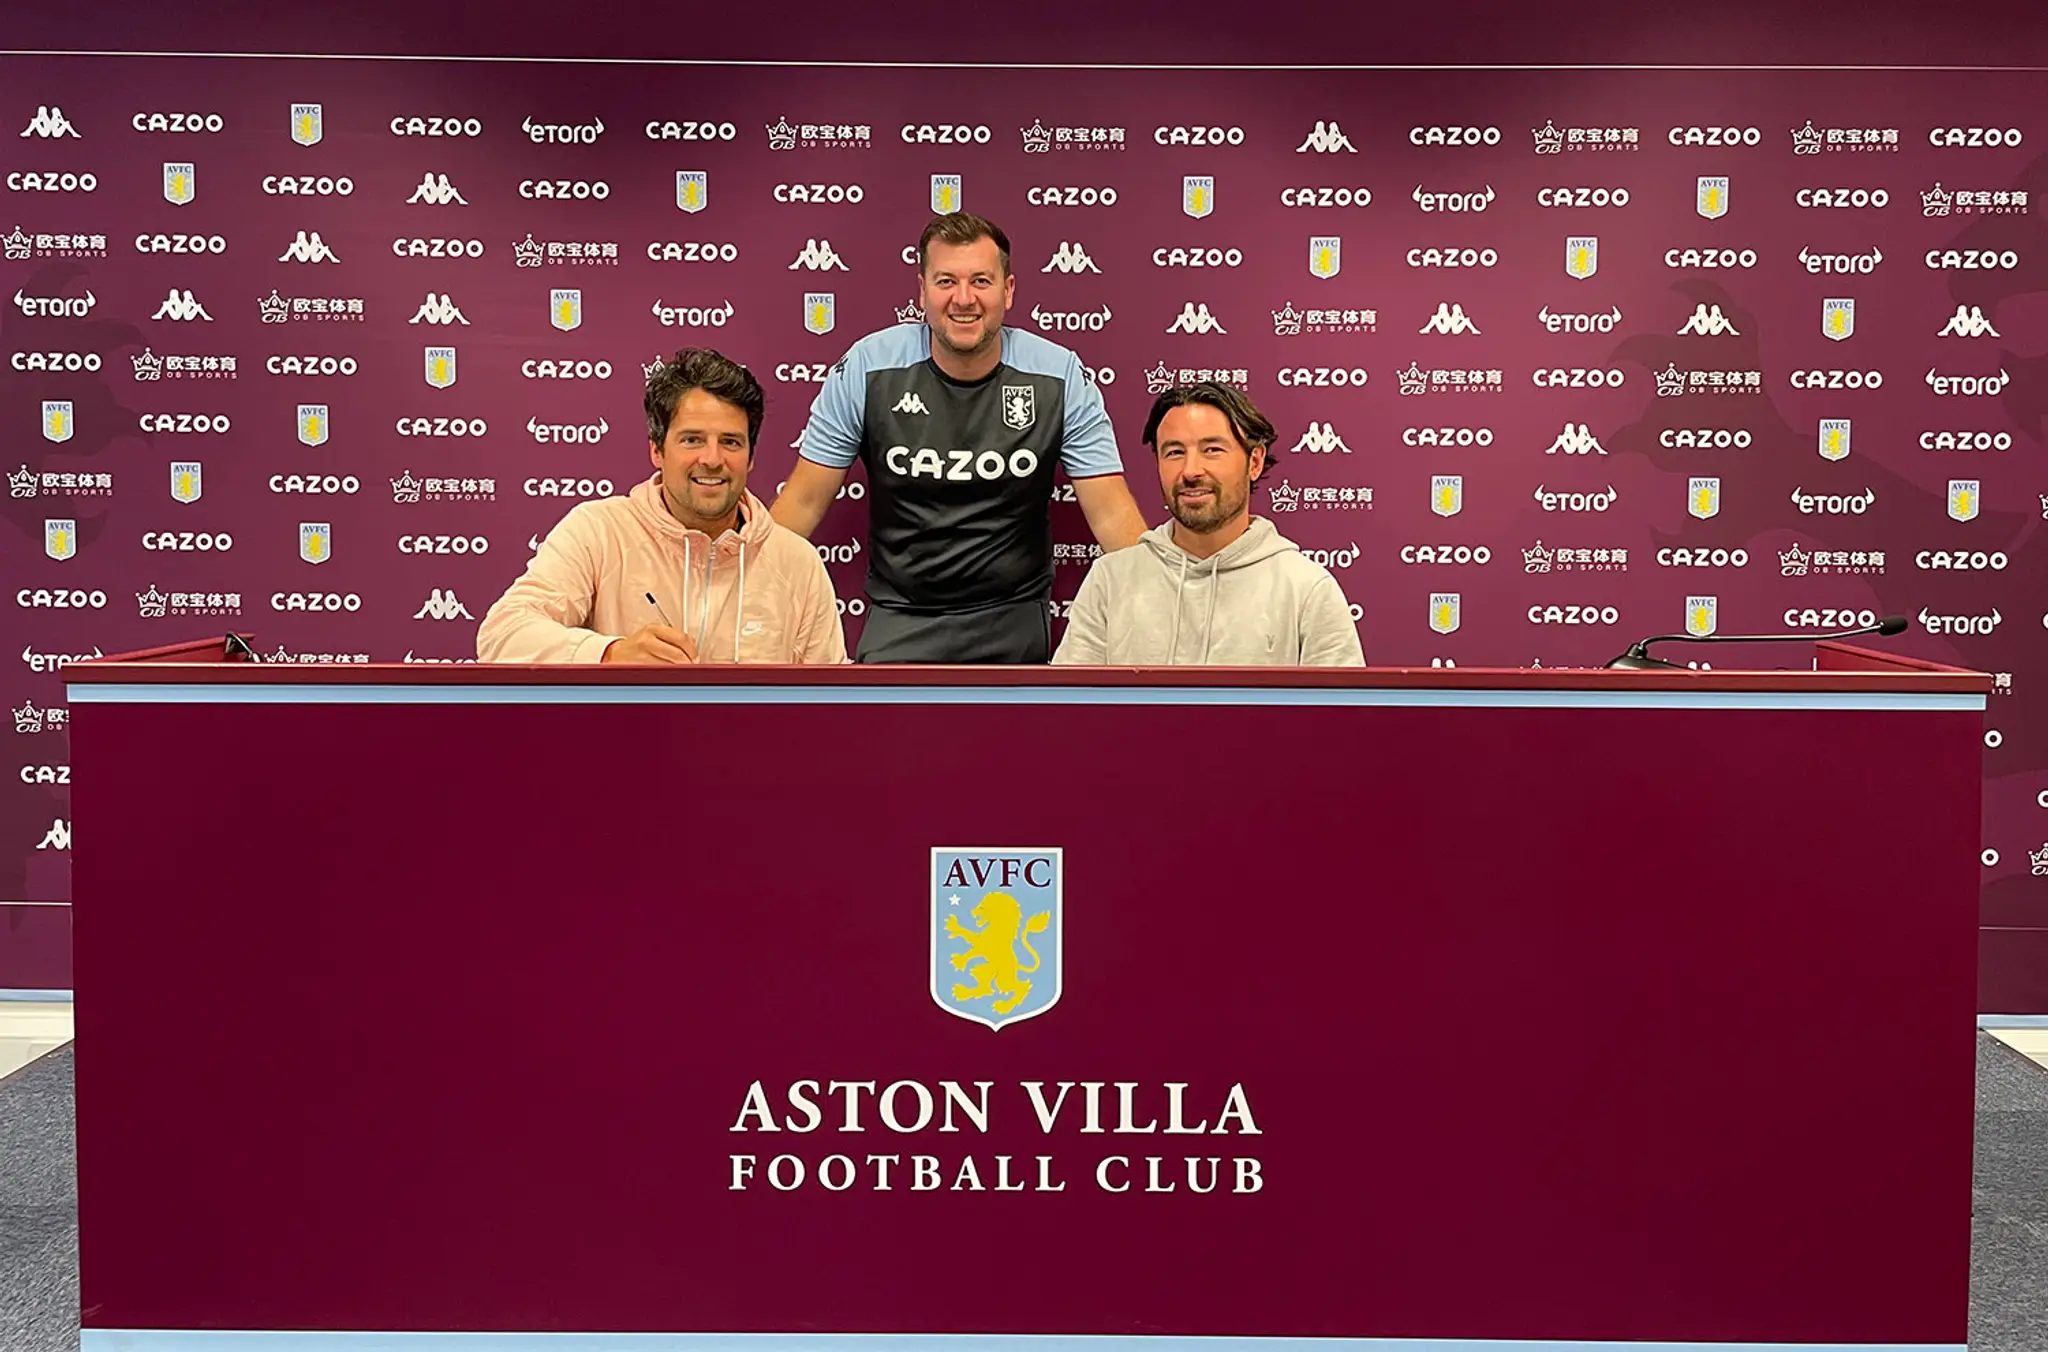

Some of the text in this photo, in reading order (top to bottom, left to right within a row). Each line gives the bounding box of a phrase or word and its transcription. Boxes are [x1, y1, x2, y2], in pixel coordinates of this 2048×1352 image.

[294, 106, 319, 115] AVFC
[132, 112, 224, 133] CAZOO
[390, 116, 482, 137] CAZOO
[645, 121, 737, 141] CAZOO
[801, 124, 871, 139] 欧宝体育
[901, 124, 992, 144] CAZOO
[1055, 127, 1126, 142] 欧宝体育
[1153, 126, 1245, 146] CAZOO
[1409, 126, 1501, 146] CAZOO
[1568, 128, 1640, 143] 欧宝体育
[1668, 126, 1761, 146] CAZOO
[1827, 129, 1900, 144] 欧宝体育
[1929, 127, 2023, 147] CAZOO
[167, 165, 192, 174] AVFC
[679, 173, 704, 182] AVFC
[6, 172, 97, 192] CAZOO
[262, 175, 354, 196] CAZOO
[518, 180, 610, 200] CAZOO
[934, 177, 959, 186] AVFC
[1186, 178, 1211, 187] AVFC
[1700, 179, 1725, 188] AVFC
[773, 184, 864, 204] CAZOO
[1027, 186, 1117, 206] CAZOO
[1280, 188, 1372, 207] CAZOO
[1537, 188, 1630, 207] CAZOO
[1796, 188, 1889, 208] CAZOO
[1956, 191, 2029, 206] 欧宝体育
[36, 234, 107, 249] 欧宝体育
[135, 234, 227, 254] CAZOO
[392, 238, 484, 258] CAZOO
[548, 242, 619, 257] 欧宝体育
[1313, 239, 1338, 248] AVFC
[1569, 239, 1594, 248] AVFC
[647, 242, 738, 262] CAZOO
[1152, 248, 1243, 267] CAZOO
[1406, 248, 1498, 267] CAZOO
[1664, 249, 1757, 268] CAZOO
[1925, 250, 2018, 269] CAZOO
[554, 291, 579, 300] AVFC
[807, 295, 832, 304] AVFC
[293, 298, 364, 313] 欧宝体育
[1826, 301, 1851, 310] AVFC
[1306, 310, 1377, 325] 欧宝体育
[10, 352, 102, 372] CAZOO
[166, 355, 237, 370] 欧宝体育
[428, 349, 453, 358] AVFC
[266, 356, 358, 376] CAZOO
[521, 359, 613, 380] CAZOO
[1277, 367, 1368, 387] CAZOO
[1432, 370, 1503, 385] 欧宝体育
[1532, 368, 1625, 388] CAZOO
[1690, 371, 1762, 386] 欧宝体育
[1790, 370, 1883, 389] CAZOO
[1005, 386, 1032, 397] AVFC
[45, 403, 70, 412] AVFC
[300, 407, 325, 416] AVFC
[139, 413, 231, 433] CAZOO
[395, 417, 487, 437] CAZOO
[1822, 421, 1847, 430] AVFC
[1402, 427, 1494, 447] CAZOO
[1659, 429, 1752, 449] CAZOO
[1919, 431, 2012, 451] CAZOO
[174, 464, 199, 473] AVFC
[886, 445, 1038, 481] CAZOO
[42, 473, 113, 488] 欧宝体育
[268, 474, 360, 494] CAZOO
[425, 478, 496, 493] 欧宝体育
[523, 478, 614, 497] CAZOO
[1435, 478, 1460, 487] AVFC
[1691, 480, 1716, 489] AVFC
[1951, 482, 1976, 491] AVFC
[1304, 487, 1374, 502] 欧宝体育
[48, 521, 73, 530] AVFC
[303, 525, 328, 534] AVFC
[141, 532, 233, 552] CAZOO
[398, 535, 489, 555] CAZOO
[1053, 544, 1104, 557] 欧宝体
[1400, 545, 1491, 564] CAZOO
[1557, 548, 1628, 563] 欧宝体育
[1656, 547, 1749, 567] CAZOO
[1814, 551, 1886, 566] 欧宝体育
[1915, 550, 2009, 570] CAZOO
[16, 589, 107, 609] CAZOO
[171, 592, 242, 607] 欧宝体育
[270, 592, 362, 612] CAZOO
[1433, 595, 1458, 604] AVFC
[1688, 598, 1713, 607] AVFC
[1527, 605, 1619, 625] CAZOO
[1784, 608, 1876, 628] CAZOO
[942, 857, 1053, 889] AVFC
[729, 1079, 1263, 1135] ASTON VILLA
[728, 1153, 1265, 1194] FOOTBALL CLUB
